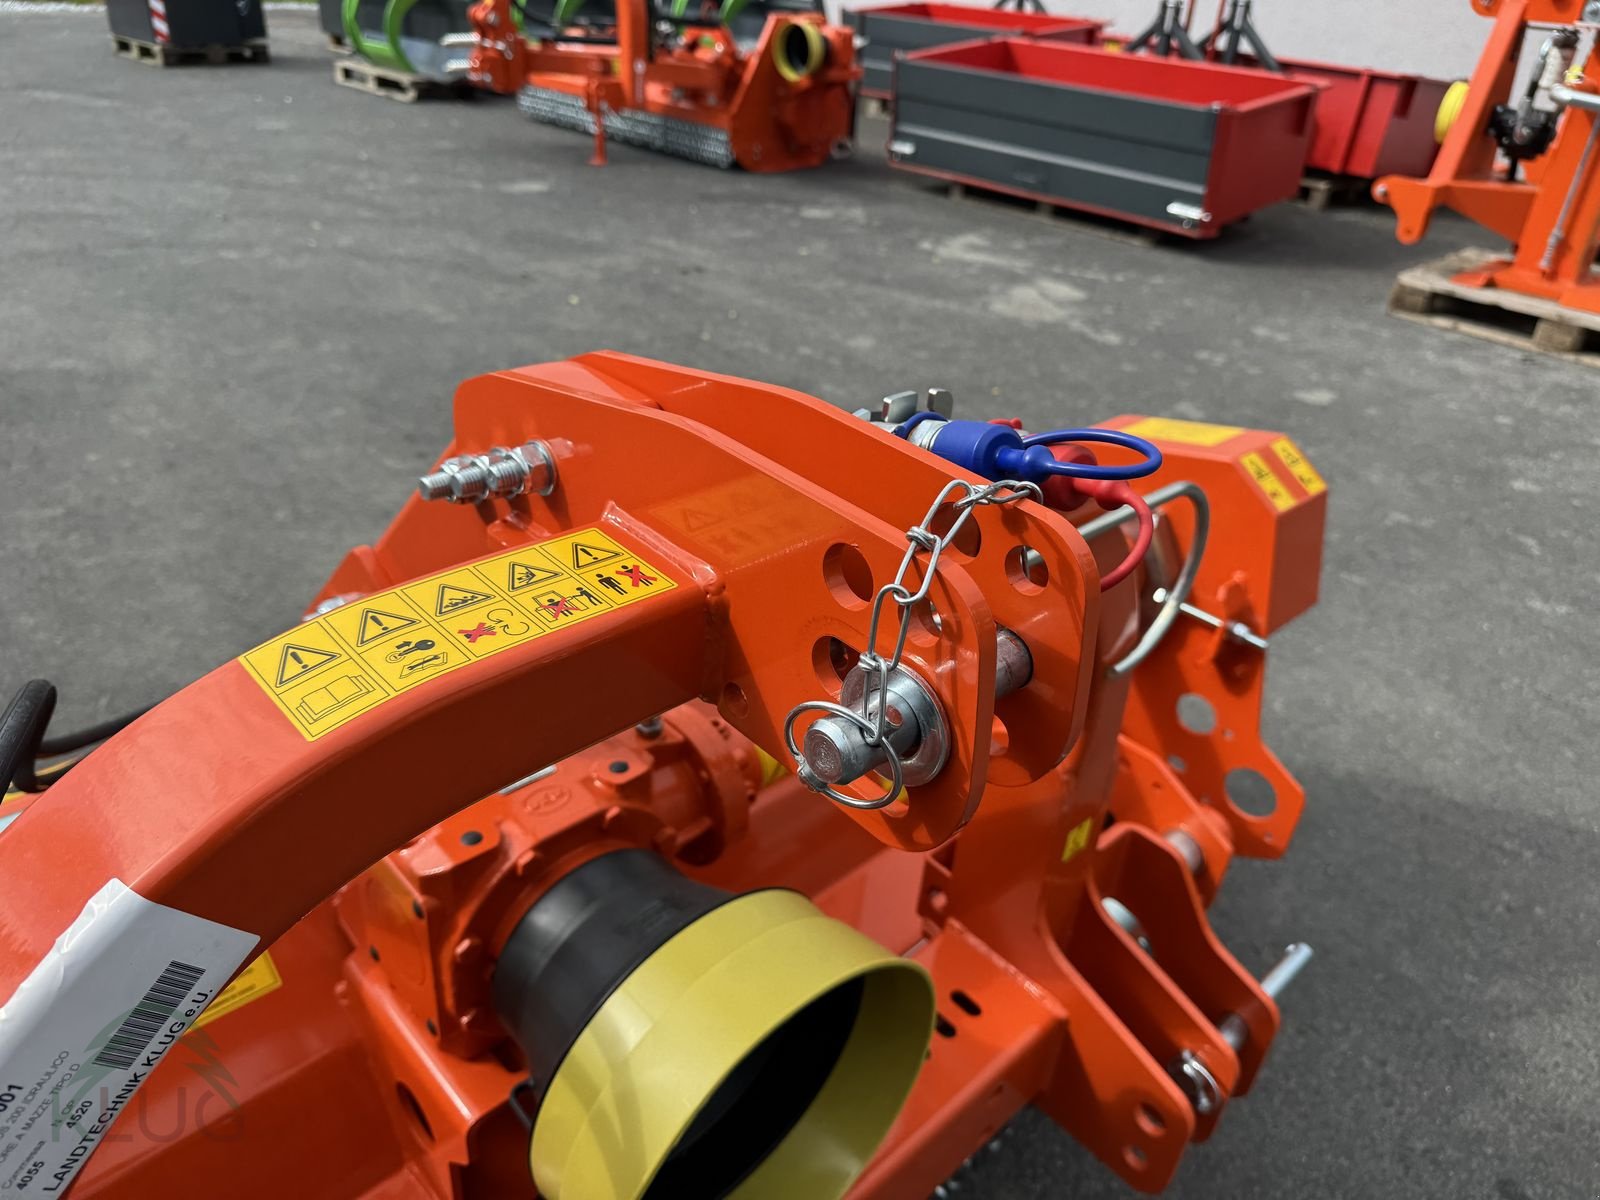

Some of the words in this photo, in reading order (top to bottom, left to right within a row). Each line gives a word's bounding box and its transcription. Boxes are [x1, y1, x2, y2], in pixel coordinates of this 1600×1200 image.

[21, 1050, 69, 1104] IDRAULICO
[42, 1071, 147, 1191] LANDTECHNIK
[141, 1021, 186, 1068] KLUG
[184, 989, 213, 1017] e.U.
[21, 1098, 54, 1131] MAZZE
[66, 1100, 93, 1129] 4520
[16, 1161, 45, 1190] 4055
